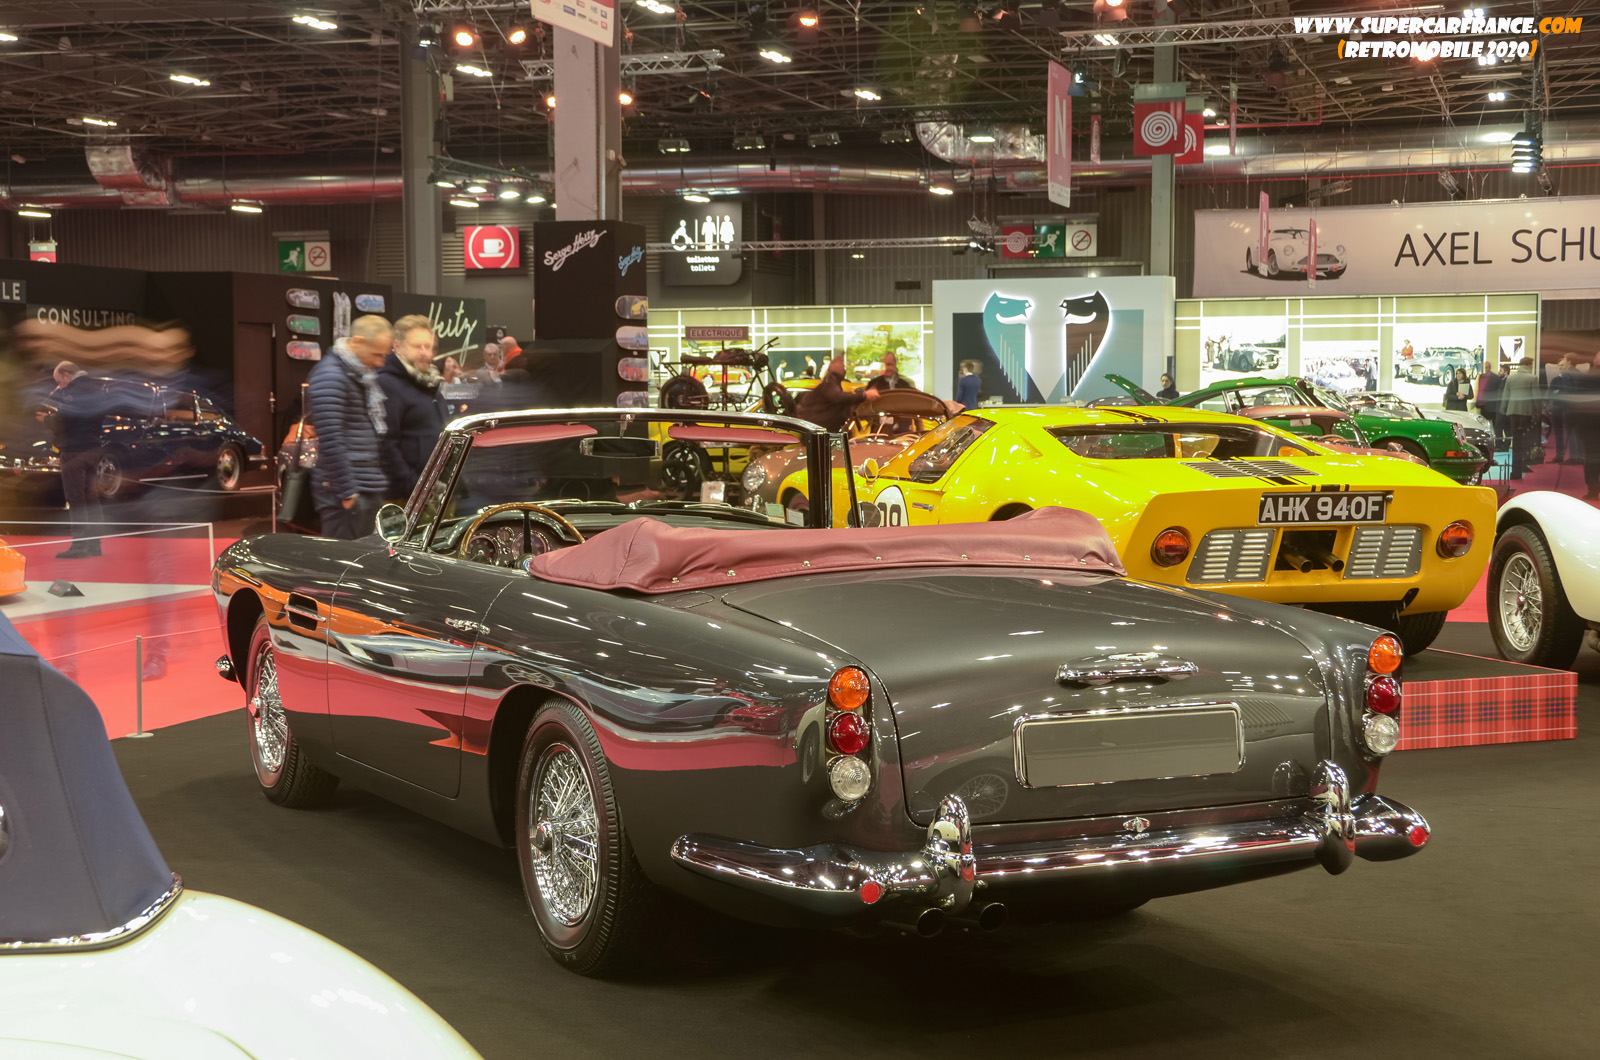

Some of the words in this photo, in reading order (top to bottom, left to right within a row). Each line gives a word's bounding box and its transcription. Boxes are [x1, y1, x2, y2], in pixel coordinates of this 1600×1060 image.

[1055, 95, 1067, 159] N
[1394, 231, 1493, 267] AXEL
[37, 307, 136, 327] CONSULTING
[1261, 497, 1310, 521] AHK
[1316, 496, 1383, 520] 940F
